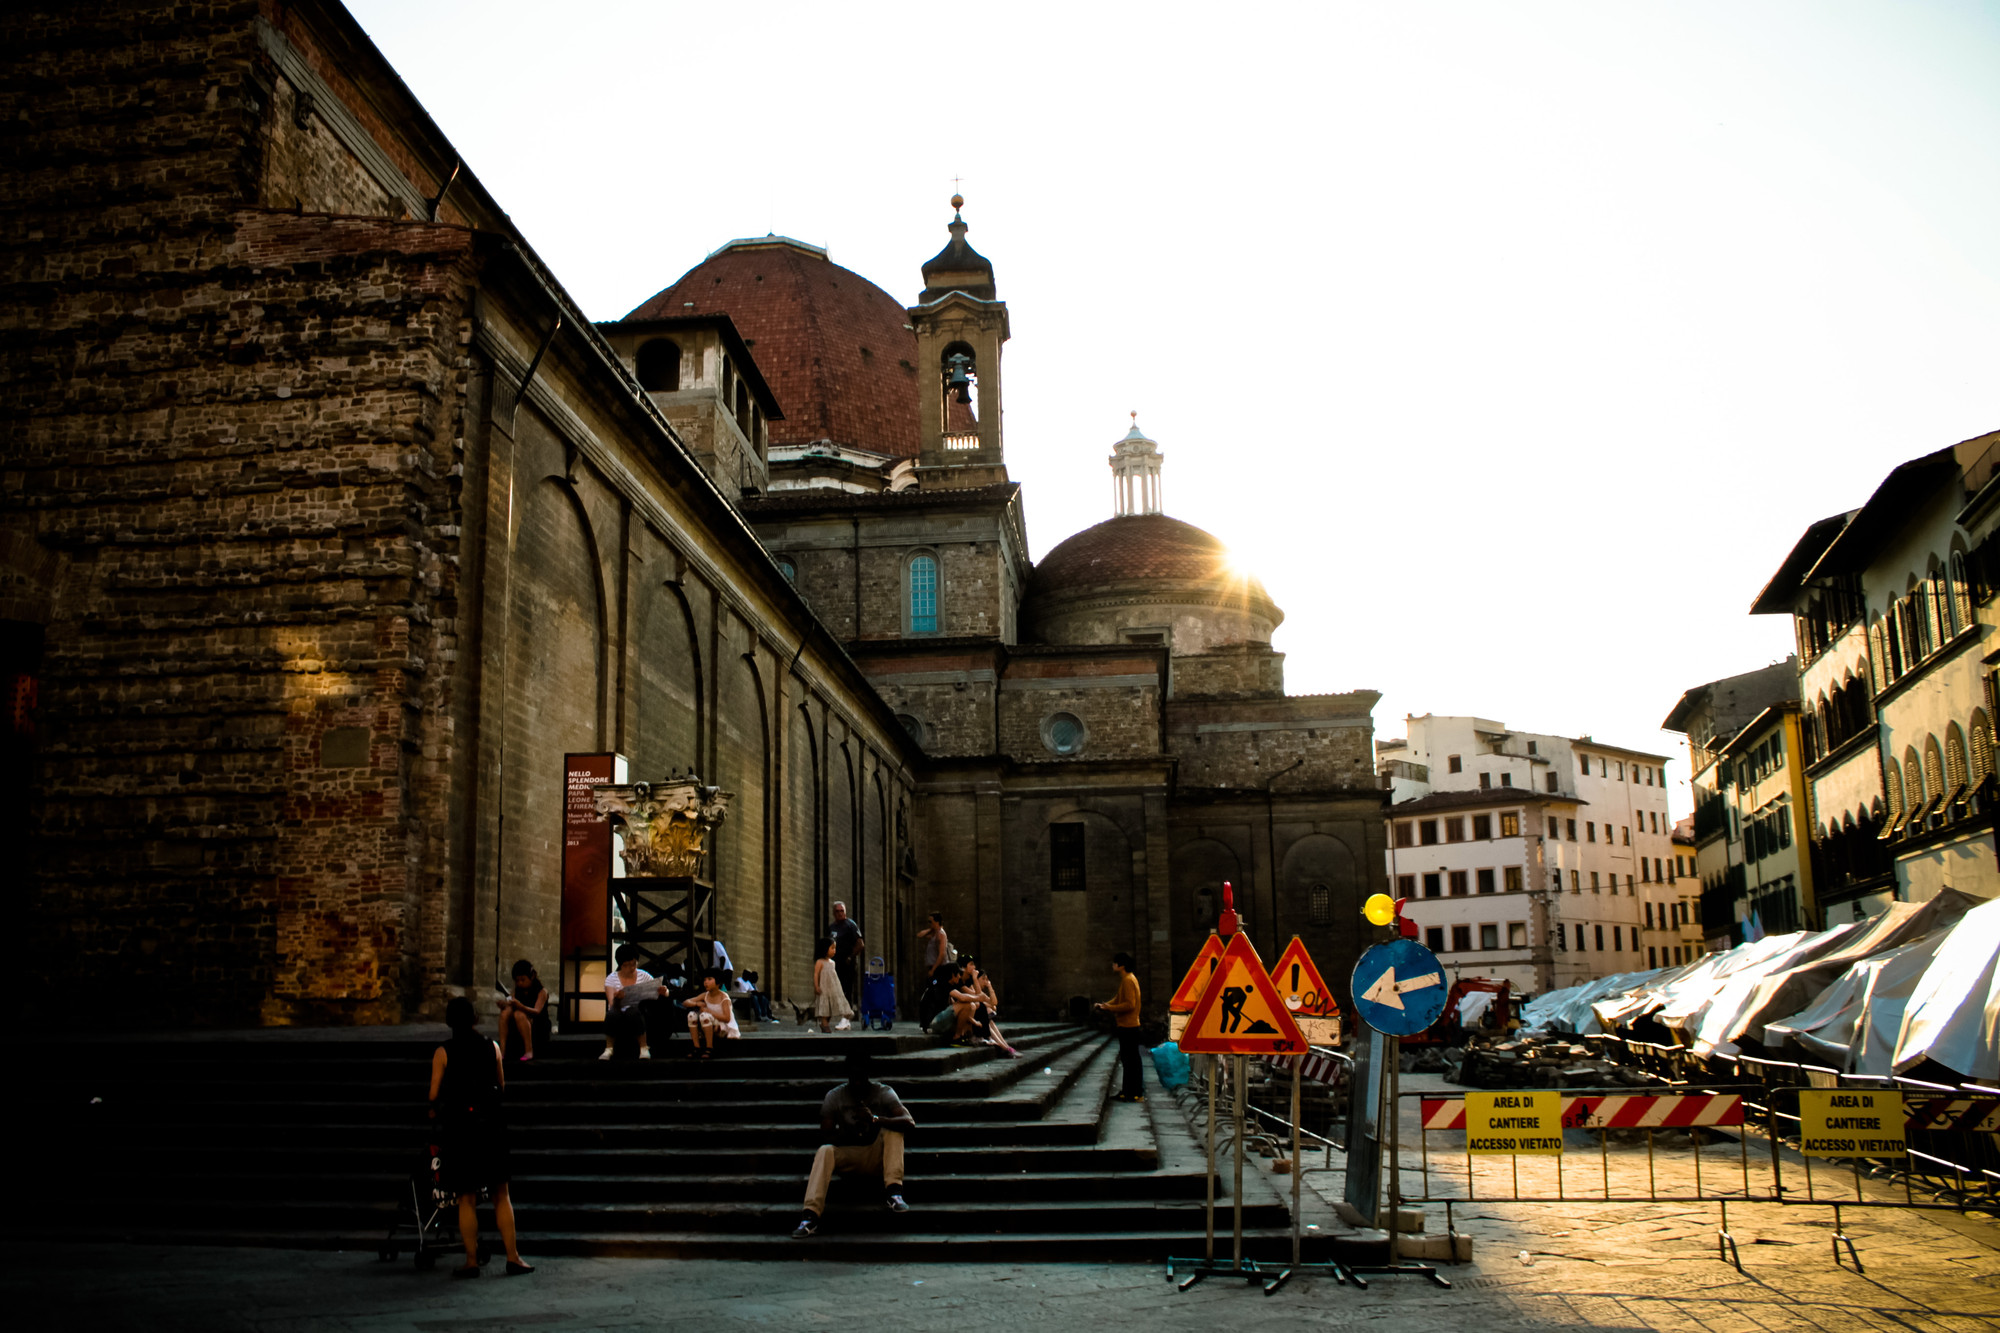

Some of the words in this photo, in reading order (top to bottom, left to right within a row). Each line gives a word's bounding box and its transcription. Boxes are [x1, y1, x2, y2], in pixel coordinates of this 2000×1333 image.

[1494, 1097, 1520, 1108] AREA
[1523, 1096, 1534, 1108] DI
[1830, 1096, 1859, 1108] AREA
[1862, 1095, 1874, 1108] DI
[1489, 1117, 1540, 1129] CANTIERE
[1825, 1117, 1881, 1130] CANTIERE
[1469, 1138, 1517, 1150] ACCESSO
[1518, 1137, 1562, 1150] VIETATO
[1805, 1138, 1856, 1151] ACCESSO
[1857, 1139, 1905, 1152] VIETATO
